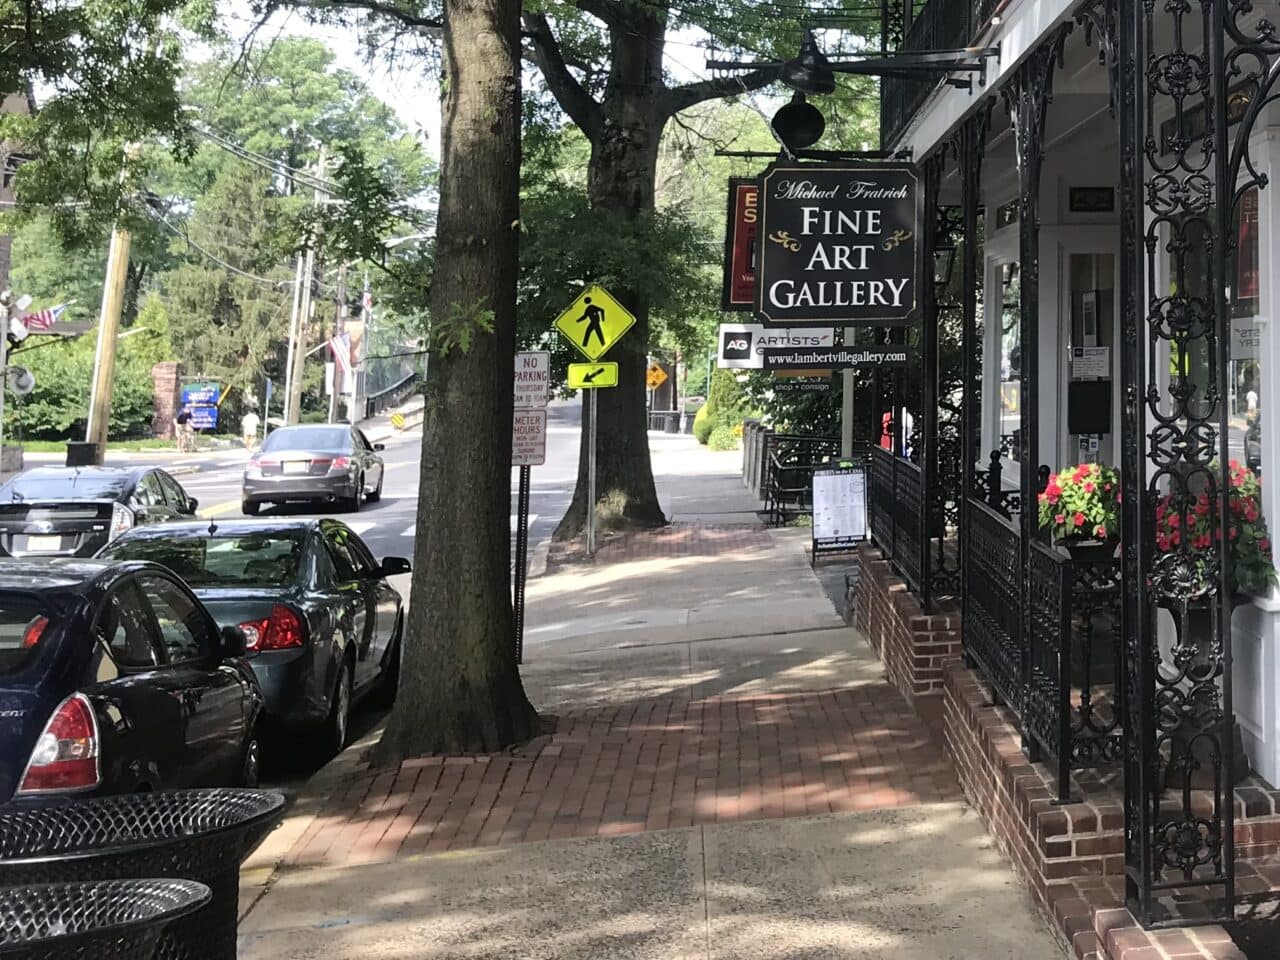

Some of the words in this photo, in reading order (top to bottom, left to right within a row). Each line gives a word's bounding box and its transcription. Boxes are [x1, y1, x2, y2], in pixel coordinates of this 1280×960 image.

[774, 180, 840, 199] Michael
[846, 181, 907, 199] Fratrich
[800, 207, 881, 235] FINE
[804, 242, 875, 271] ART
[769, 278, 910, 308] GALLERY
[523, 357, 538, 369] NO
[768, 351, 906, 364] www.lambertvillegallery.com
[513, 371, 547, 382] PARKING
[515, 415, 541, 425] METER
[513, 425, 541, 435] HOURS
